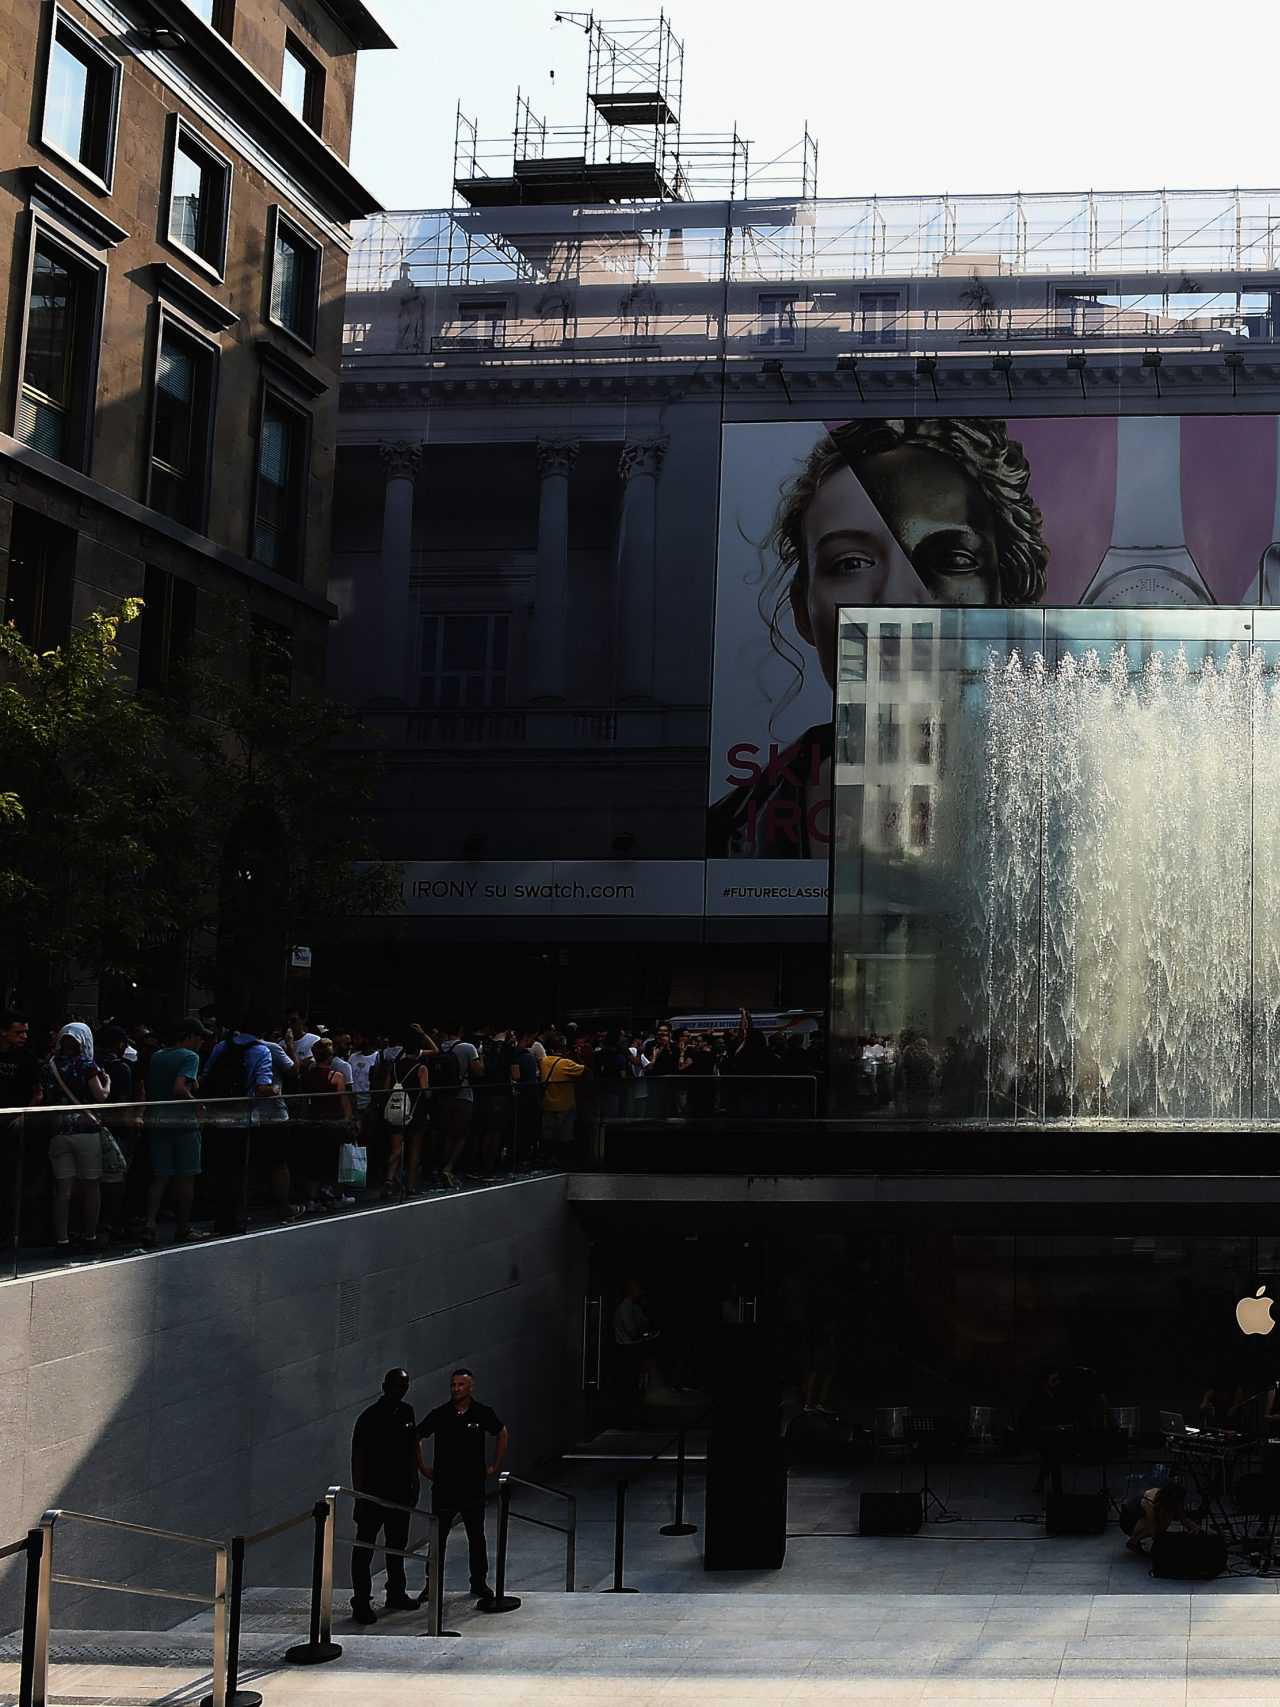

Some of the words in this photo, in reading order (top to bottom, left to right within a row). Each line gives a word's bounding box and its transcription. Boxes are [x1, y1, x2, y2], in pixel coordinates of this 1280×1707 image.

[726, 743, 821, 787] SKI
[412, 881, 478, 898] IRONY
[485, 884, 507, 898] su
[514, 881, 634, 898] swatch.com
